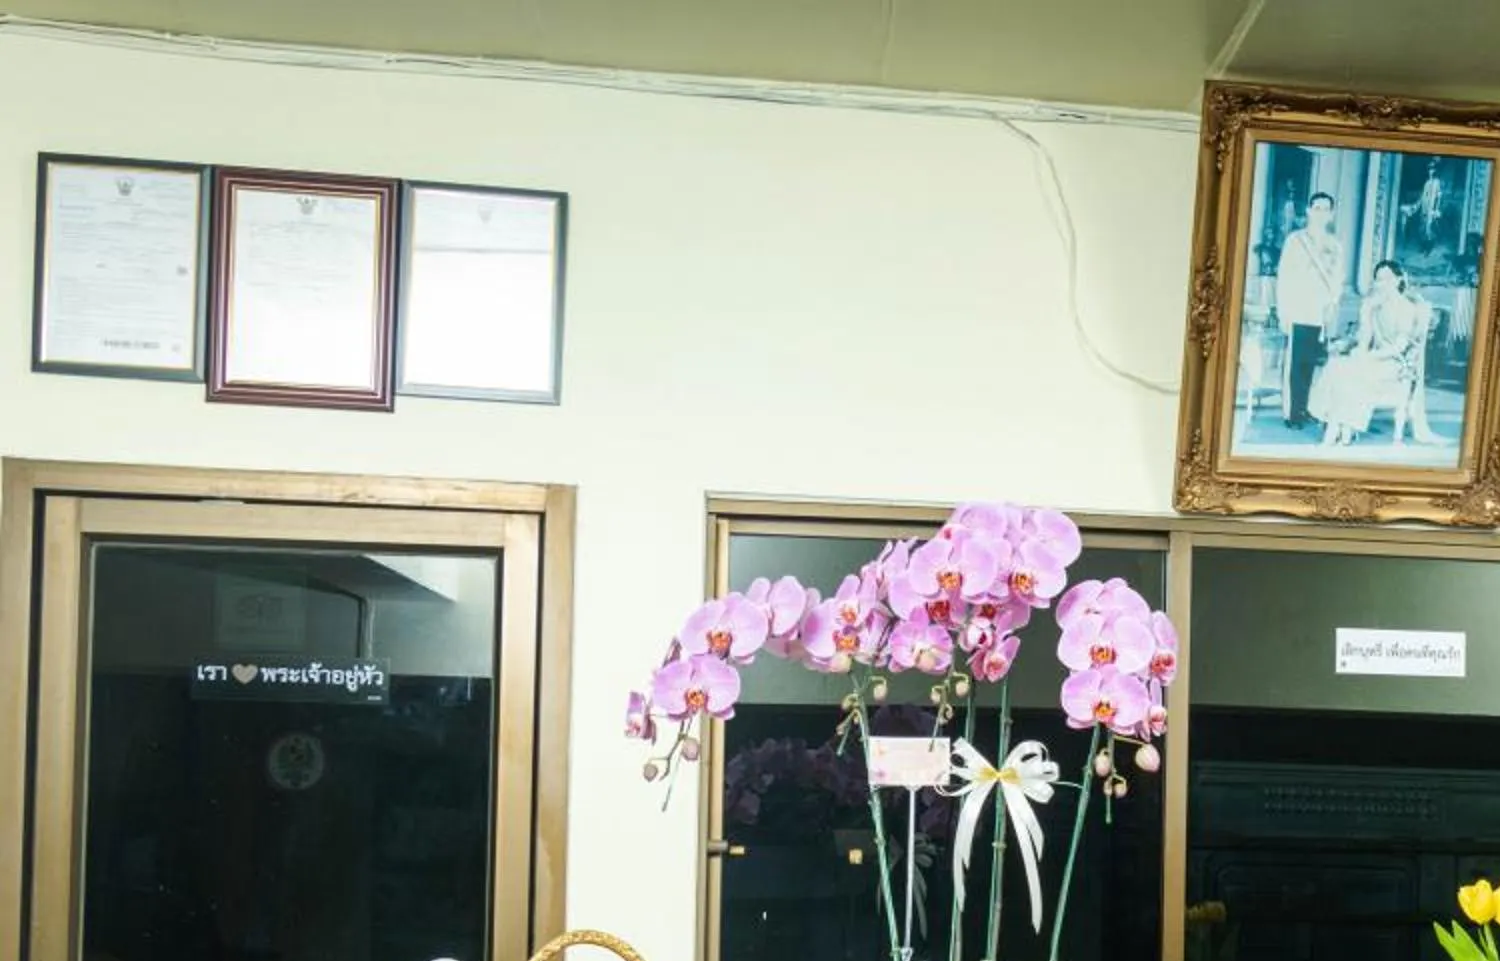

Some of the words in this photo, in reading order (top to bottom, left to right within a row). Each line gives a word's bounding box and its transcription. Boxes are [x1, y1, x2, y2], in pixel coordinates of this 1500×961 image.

[197, 663, 228, 682] เรา
[260, 662, 384, 693] พระเจ้าอยู่หัว
